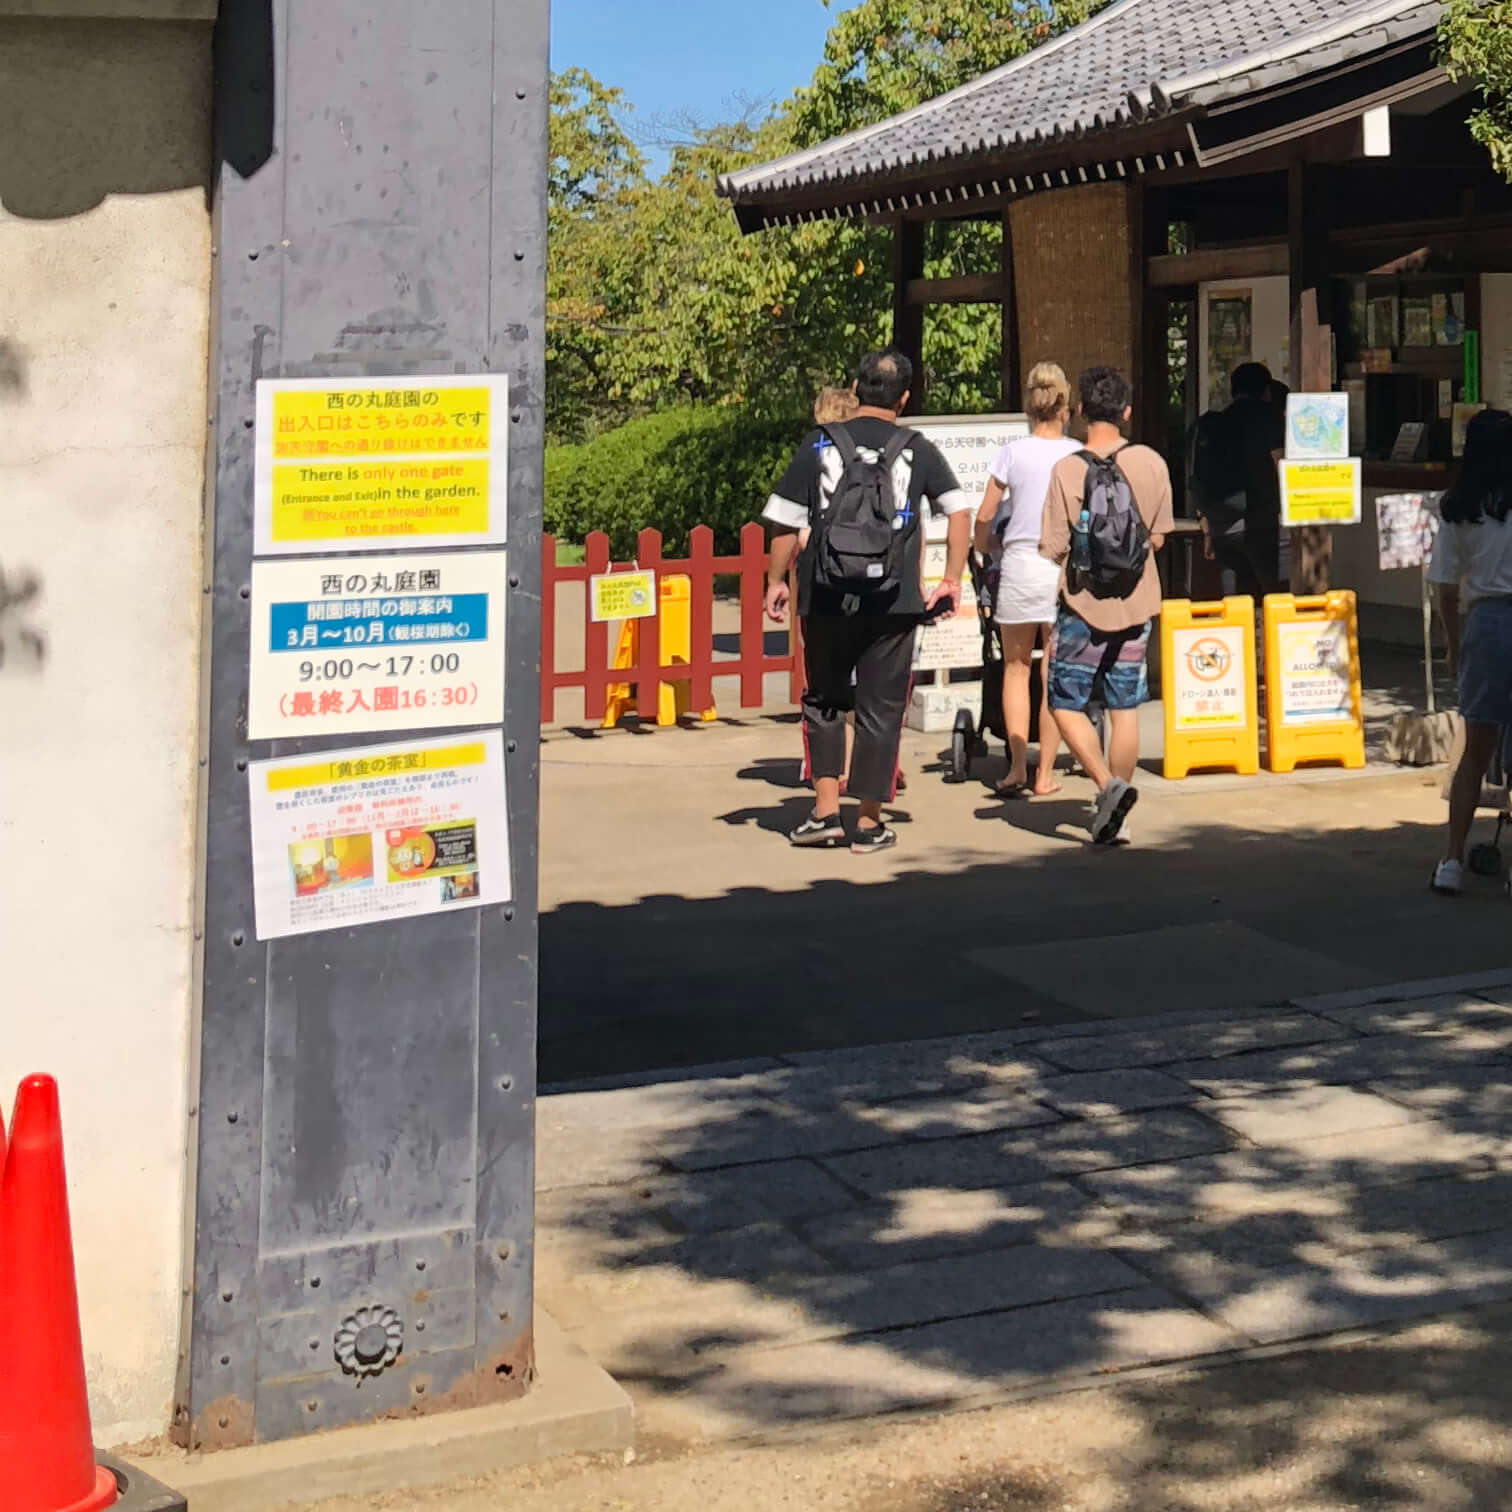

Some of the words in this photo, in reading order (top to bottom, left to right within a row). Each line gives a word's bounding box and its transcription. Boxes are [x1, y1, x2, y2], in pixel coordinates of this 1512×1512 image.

[327, 391, 439, 409] 西の丸庭園の
[300, 469, 342, 481] There
[348, 467, 359, 479] is
[363, 468, 395, 480] only
[400, 467, 427, 478] one
[432, 465, 464, 479] gate
[282, 494, 330, 505] (Entrance
[333, 492, 353, 502] and
[397, 486, 420, 499] the
[425, 485, 480, 501] garden.
[387, 505, 432, 519] through
[361, 523, 380, 534] the
[321, 569, 441, 594] 西の丸庭園
[307, 598, 453, 621] 開園時間の御案内
